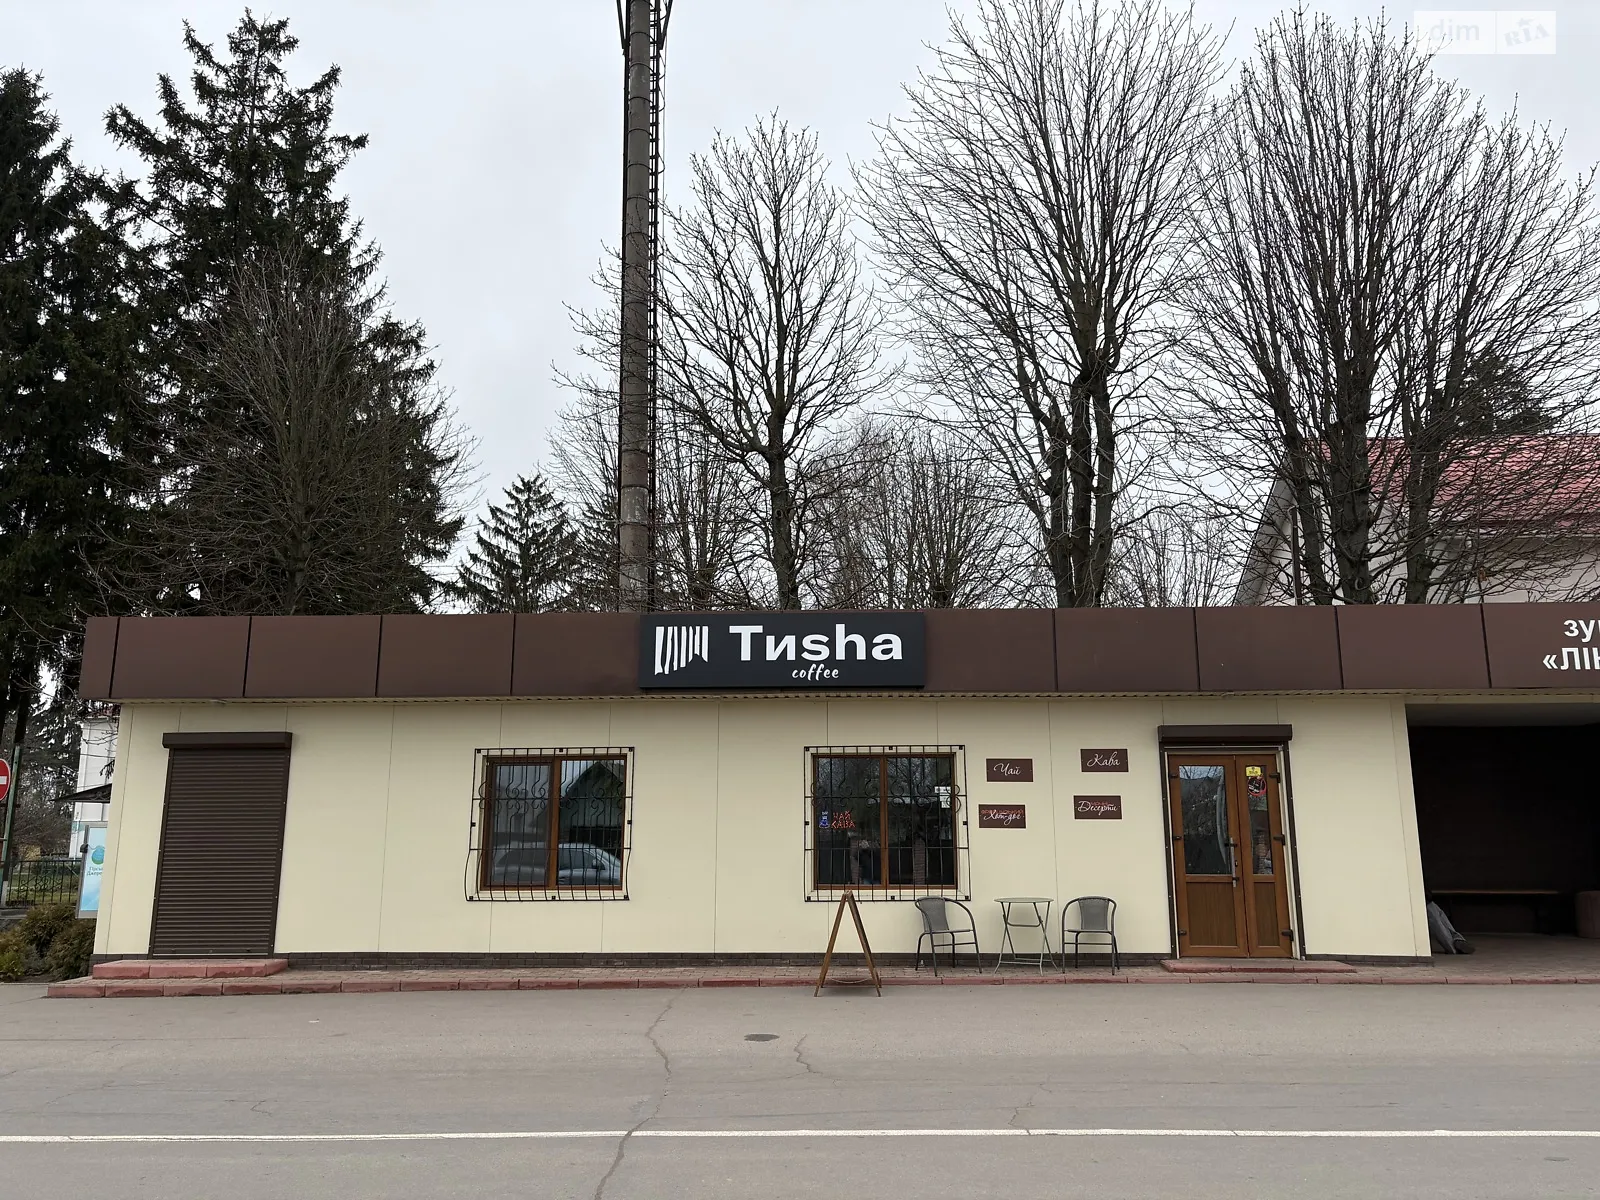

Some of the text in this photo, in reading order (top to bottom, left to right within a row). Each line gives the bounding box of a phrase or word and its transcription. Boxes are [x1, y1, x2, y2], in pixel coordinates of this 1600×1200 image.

[1563, 619, 1600, 643] зу
[791, 664, 840, 681] coffee
[1086, 751, 1121, 767] Кава
[993, 762, 1022, 776] Чай
[1077, 800, 1118, 816] Десерти
